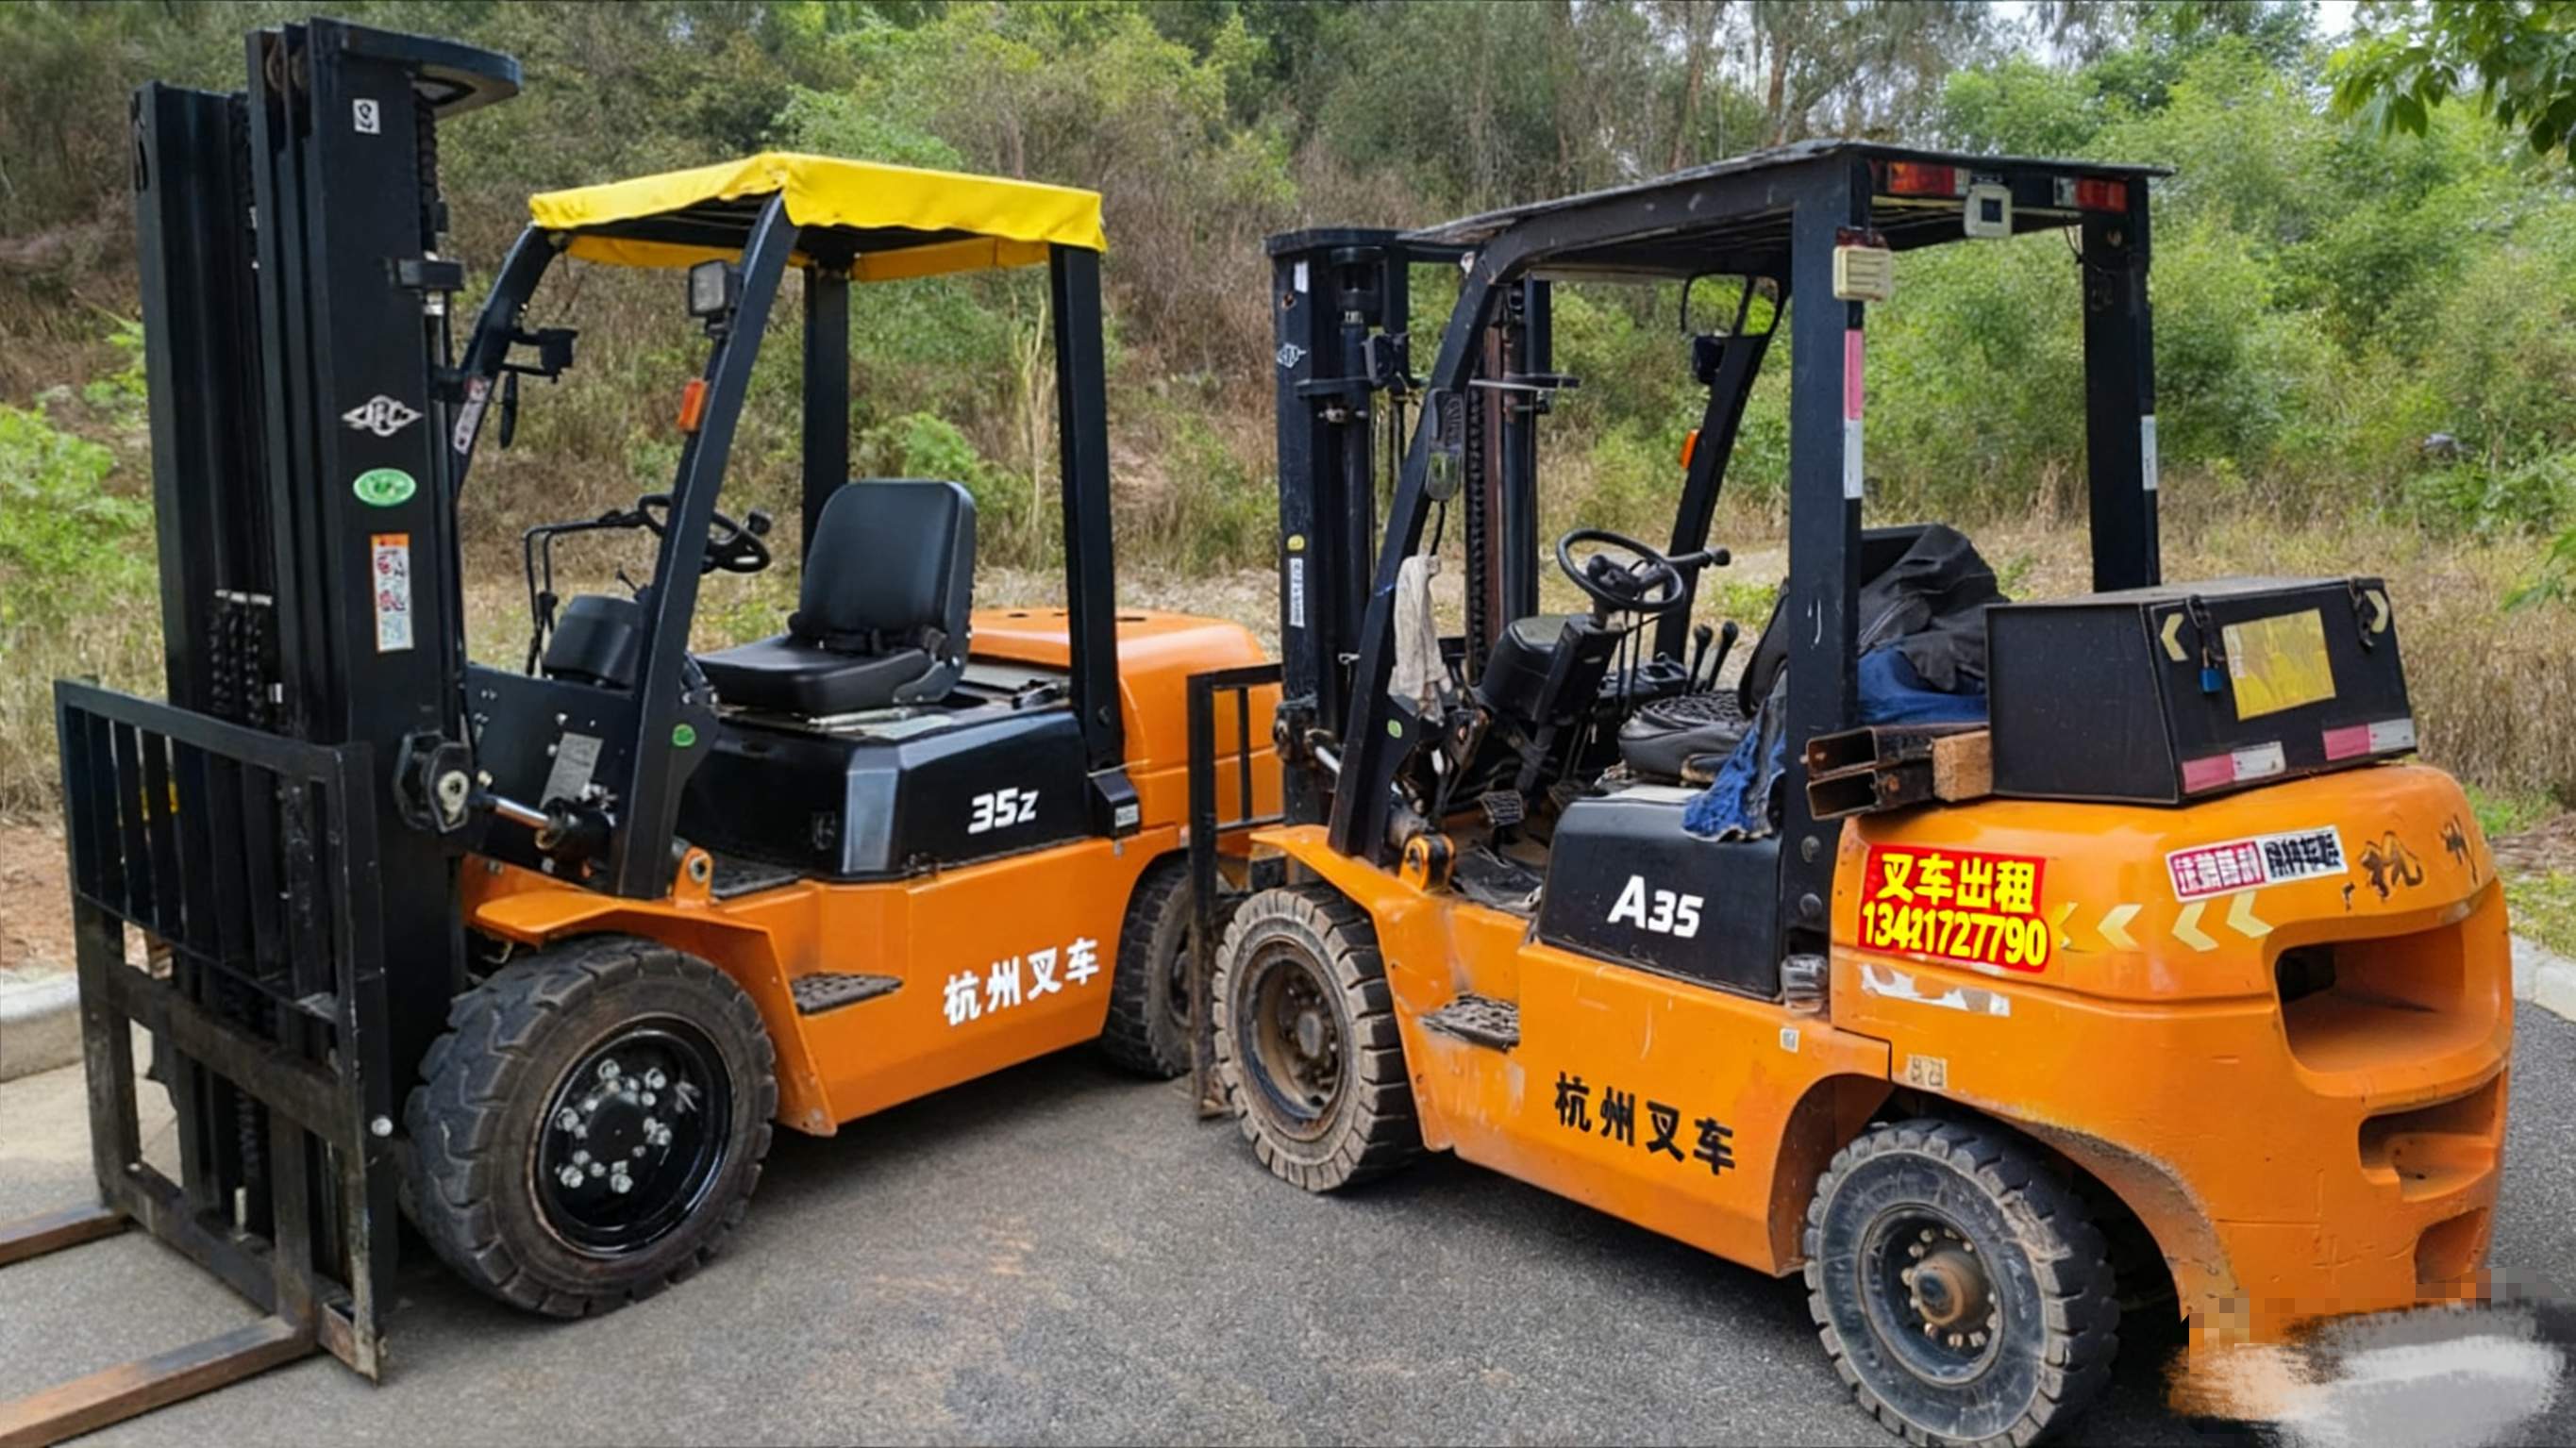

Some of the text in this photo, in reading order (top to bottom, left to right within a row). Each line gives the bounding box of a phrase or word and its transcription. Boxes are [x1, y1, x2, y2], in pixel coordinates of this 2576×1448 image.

[1607, 874, 1704, 939] A35
[1876, 852, 2035, 913] 叉车出租
[944, 937, 1100, 1026] 杭州叉车
[1554, 1072, 1735, 1176] 杭州叉车
